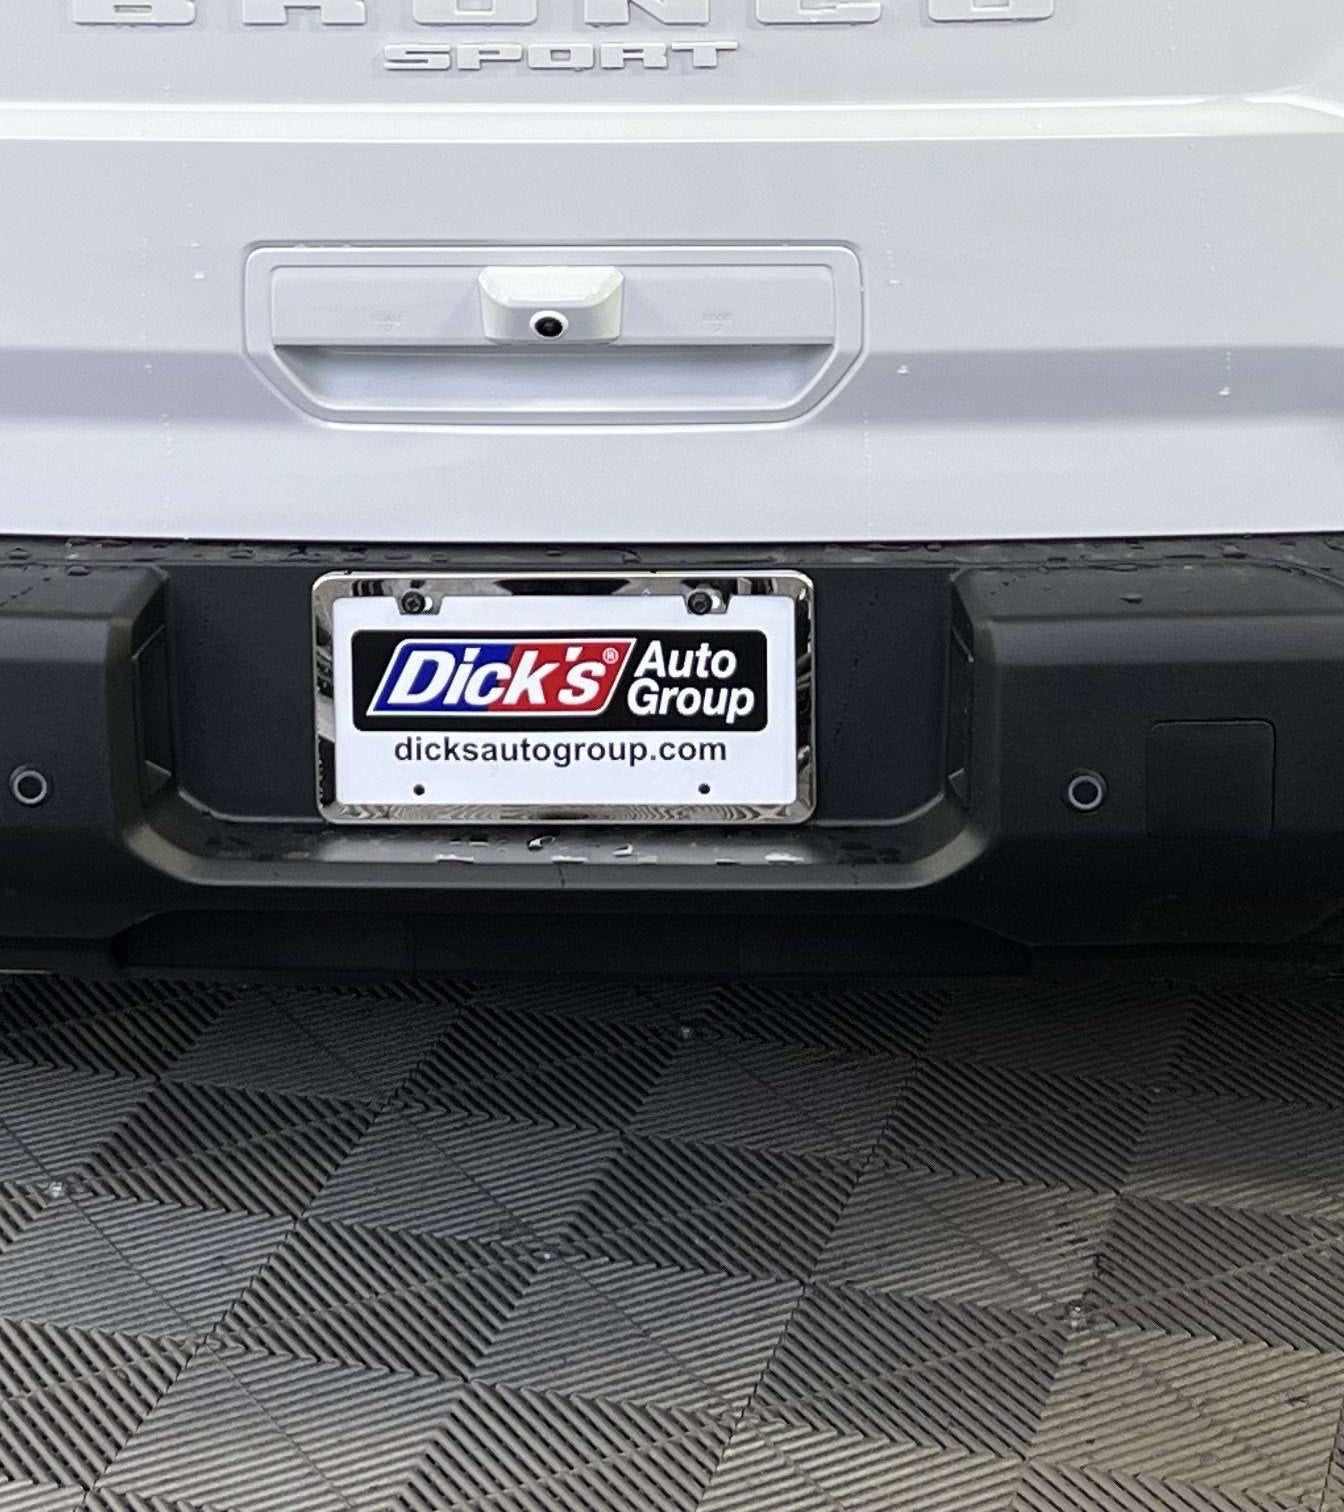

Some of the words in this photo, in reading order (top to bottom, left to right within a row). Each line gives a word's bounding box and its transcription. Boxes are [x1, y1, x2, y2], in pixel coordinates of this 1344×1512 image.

[384, 39, 739, 72] SPORT
[634, 640, 737, 680] Auto
[627, 680, 755, 724] Group
[394, 736, 727, 768] dicksautogroup.com
